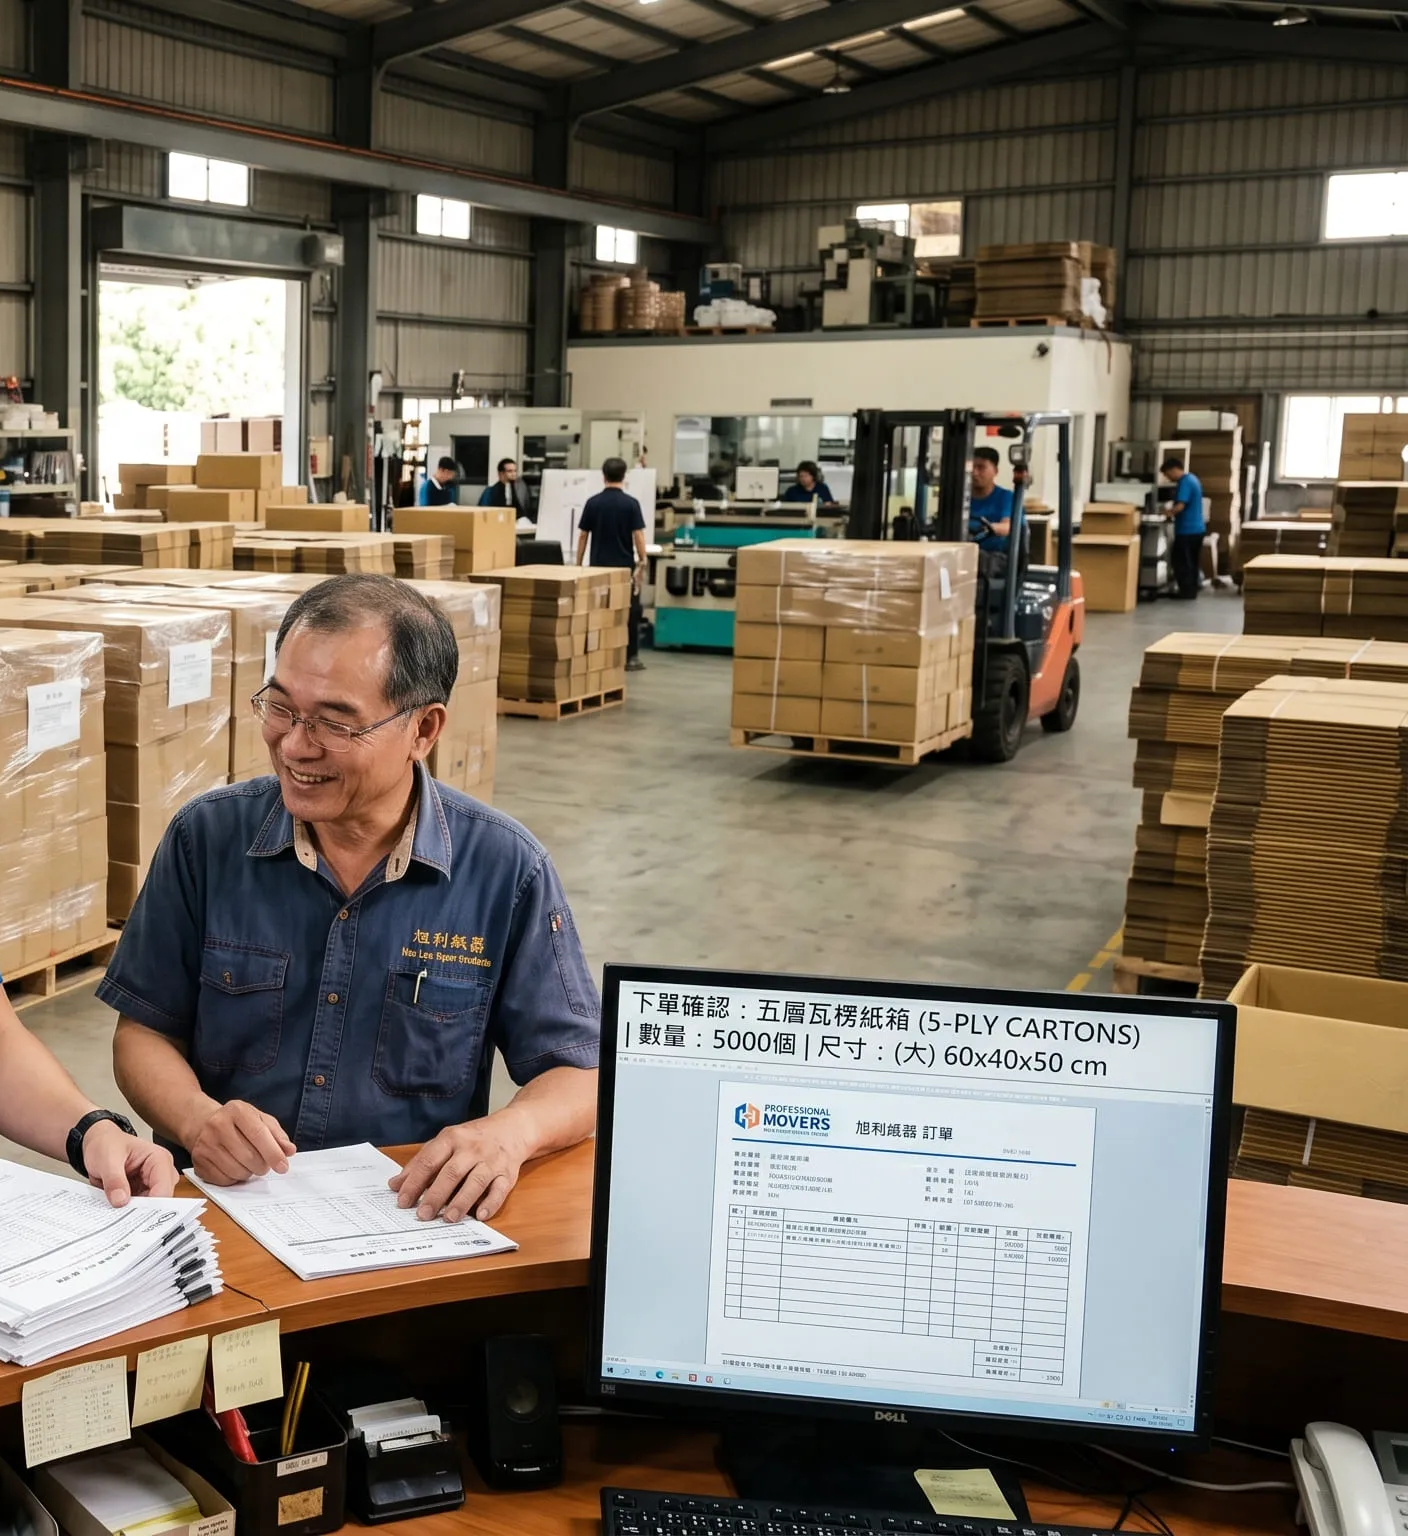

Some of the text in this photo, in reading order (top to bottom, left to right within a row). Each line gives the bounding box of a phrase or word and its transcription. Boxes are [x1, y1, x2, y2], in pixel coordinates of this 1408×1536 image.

[633, 991, 1141, 1050] 下單確認：五層瓦楞紙箱 (5-PLY CARTONS)
[638, 1022, 796, 1056] 數量：5000個
[817, 1035, 936, 1068] 尺寸：(大)
[944, 1045, 1064, 1074] 60x40x50
[1070, 1057, 1108, 1077] cm
[763, 1103, 832, 1117] PROFESSIONAL
[762, 1113, 831, 1131] MOVERS
[922, 1125, 954, 1142] 訂單
